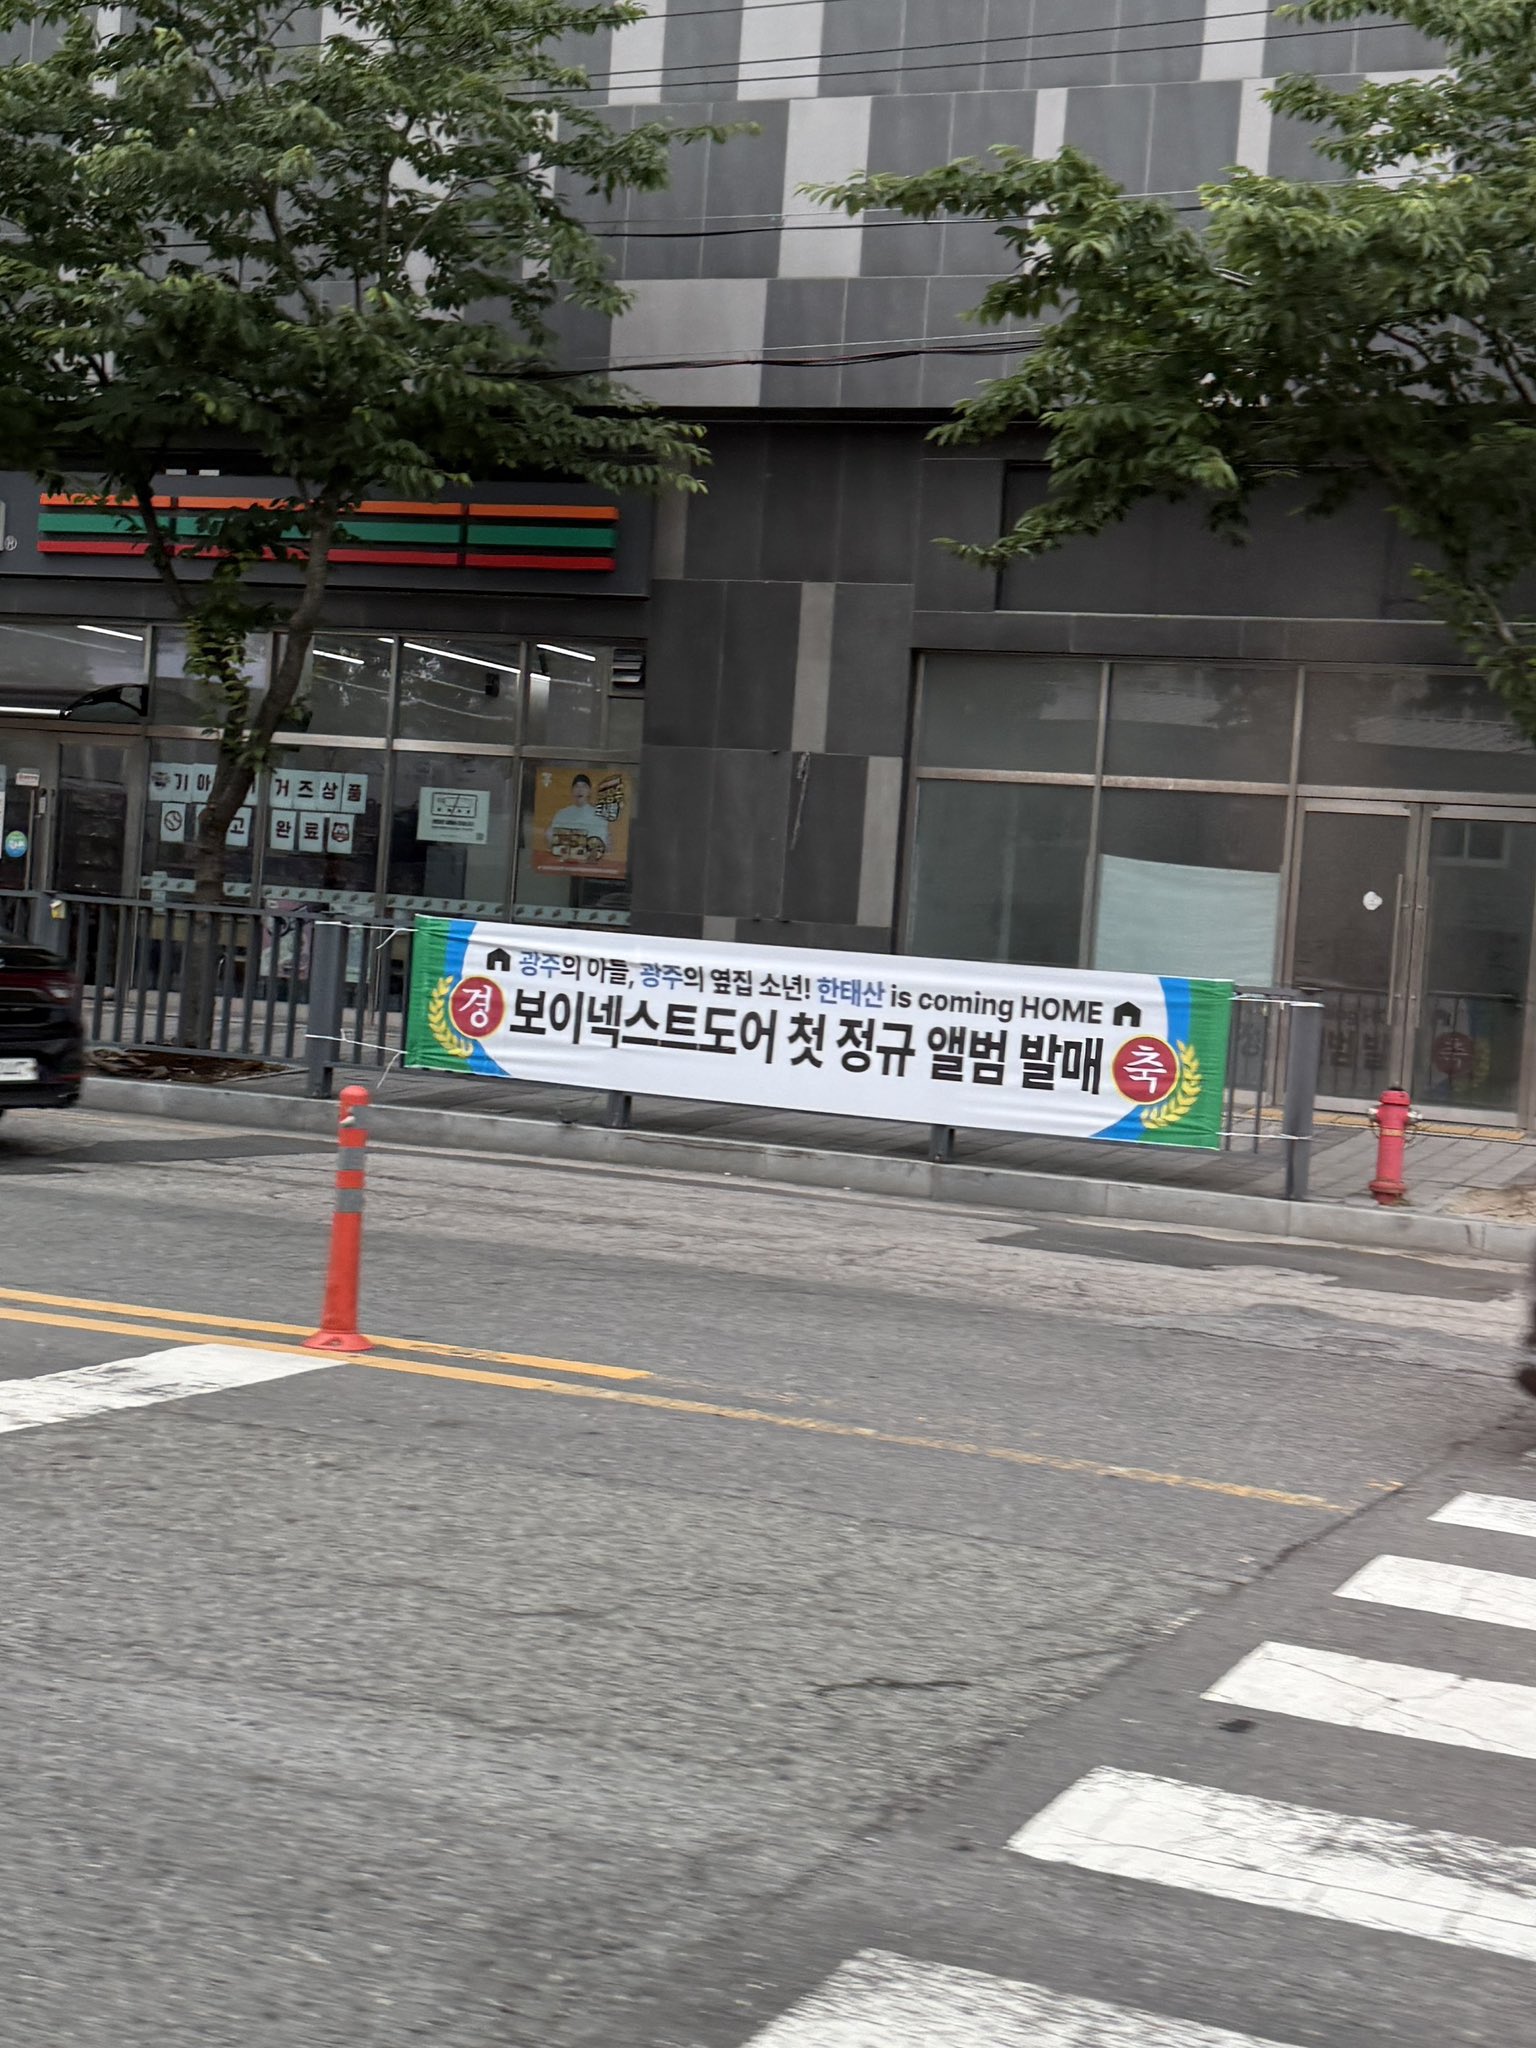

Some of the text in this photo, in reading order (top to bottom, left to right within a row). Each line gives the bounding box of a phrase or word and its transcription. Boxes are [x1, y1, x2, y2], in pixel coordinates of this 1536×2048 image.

[276, 820, 319, 840] 완료
[458, 984, 492, 1029] 경
[519, 951, 1103, 1025] 광주의 아들, 광주의 옆집 소년! 한태산 is coming HOME
[510, 989, 1104, 1095] 보이넥스트도어 첫 정규 앨범 발매
[1122, 1045, 1168, 1095] 축
